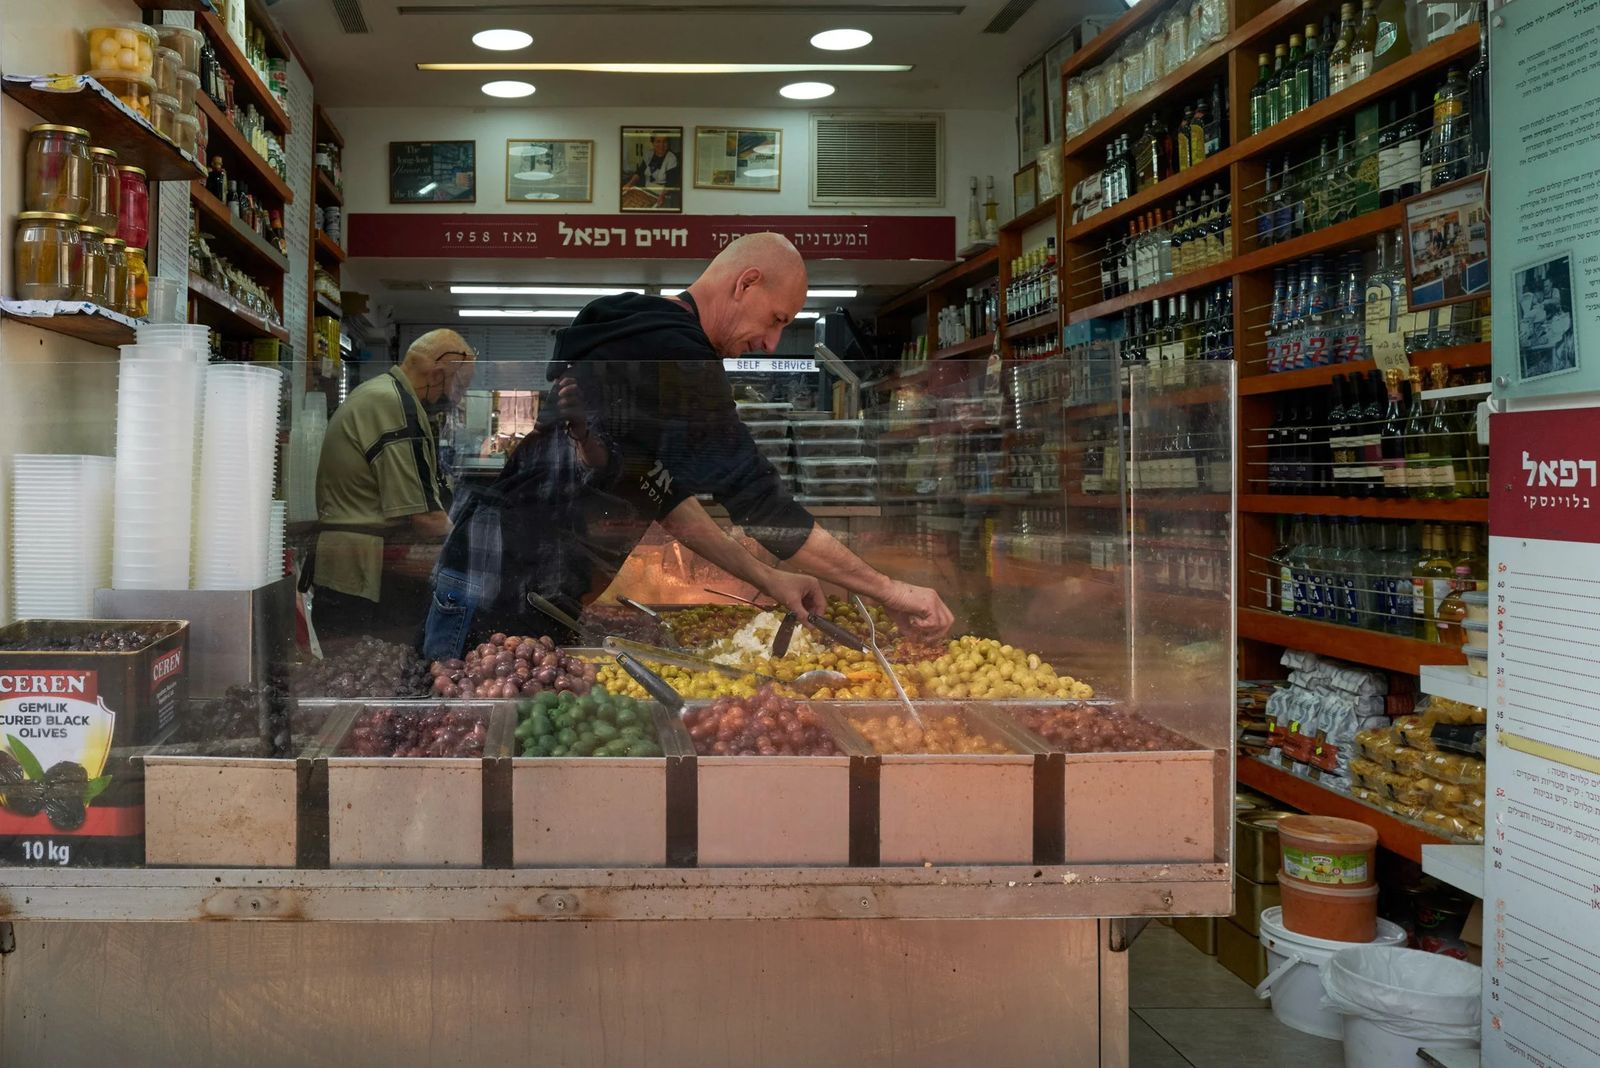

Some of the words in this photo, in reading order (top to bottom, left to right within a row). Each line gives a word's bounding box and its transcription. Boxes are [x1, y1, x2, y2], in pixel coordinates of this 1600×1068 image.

[444, 231, 490, 243] 1958
[502, 231, 537, 243] מאז
[558, 221, 626, 246] רפאל
[635, 228, 688, 247] חיים
[795, 233, 868, 246] המעדניה
[737, 360, 760, 370] SELF
[771, 360, 812, 370] SERVICE
[1522, 450, 1597, 487] רפאל
[1523, 493, 1590, 509] בלוינסקי
[153, 650, 181, 680] CEREN
[0, 674, 85, 693] CEREN
[18, 703, 68, 713] GEMLIK
[46, 715, 90, 726] BLACK
[22, 841, 44, 860] 10
[49, 840, 70, 864] kg
